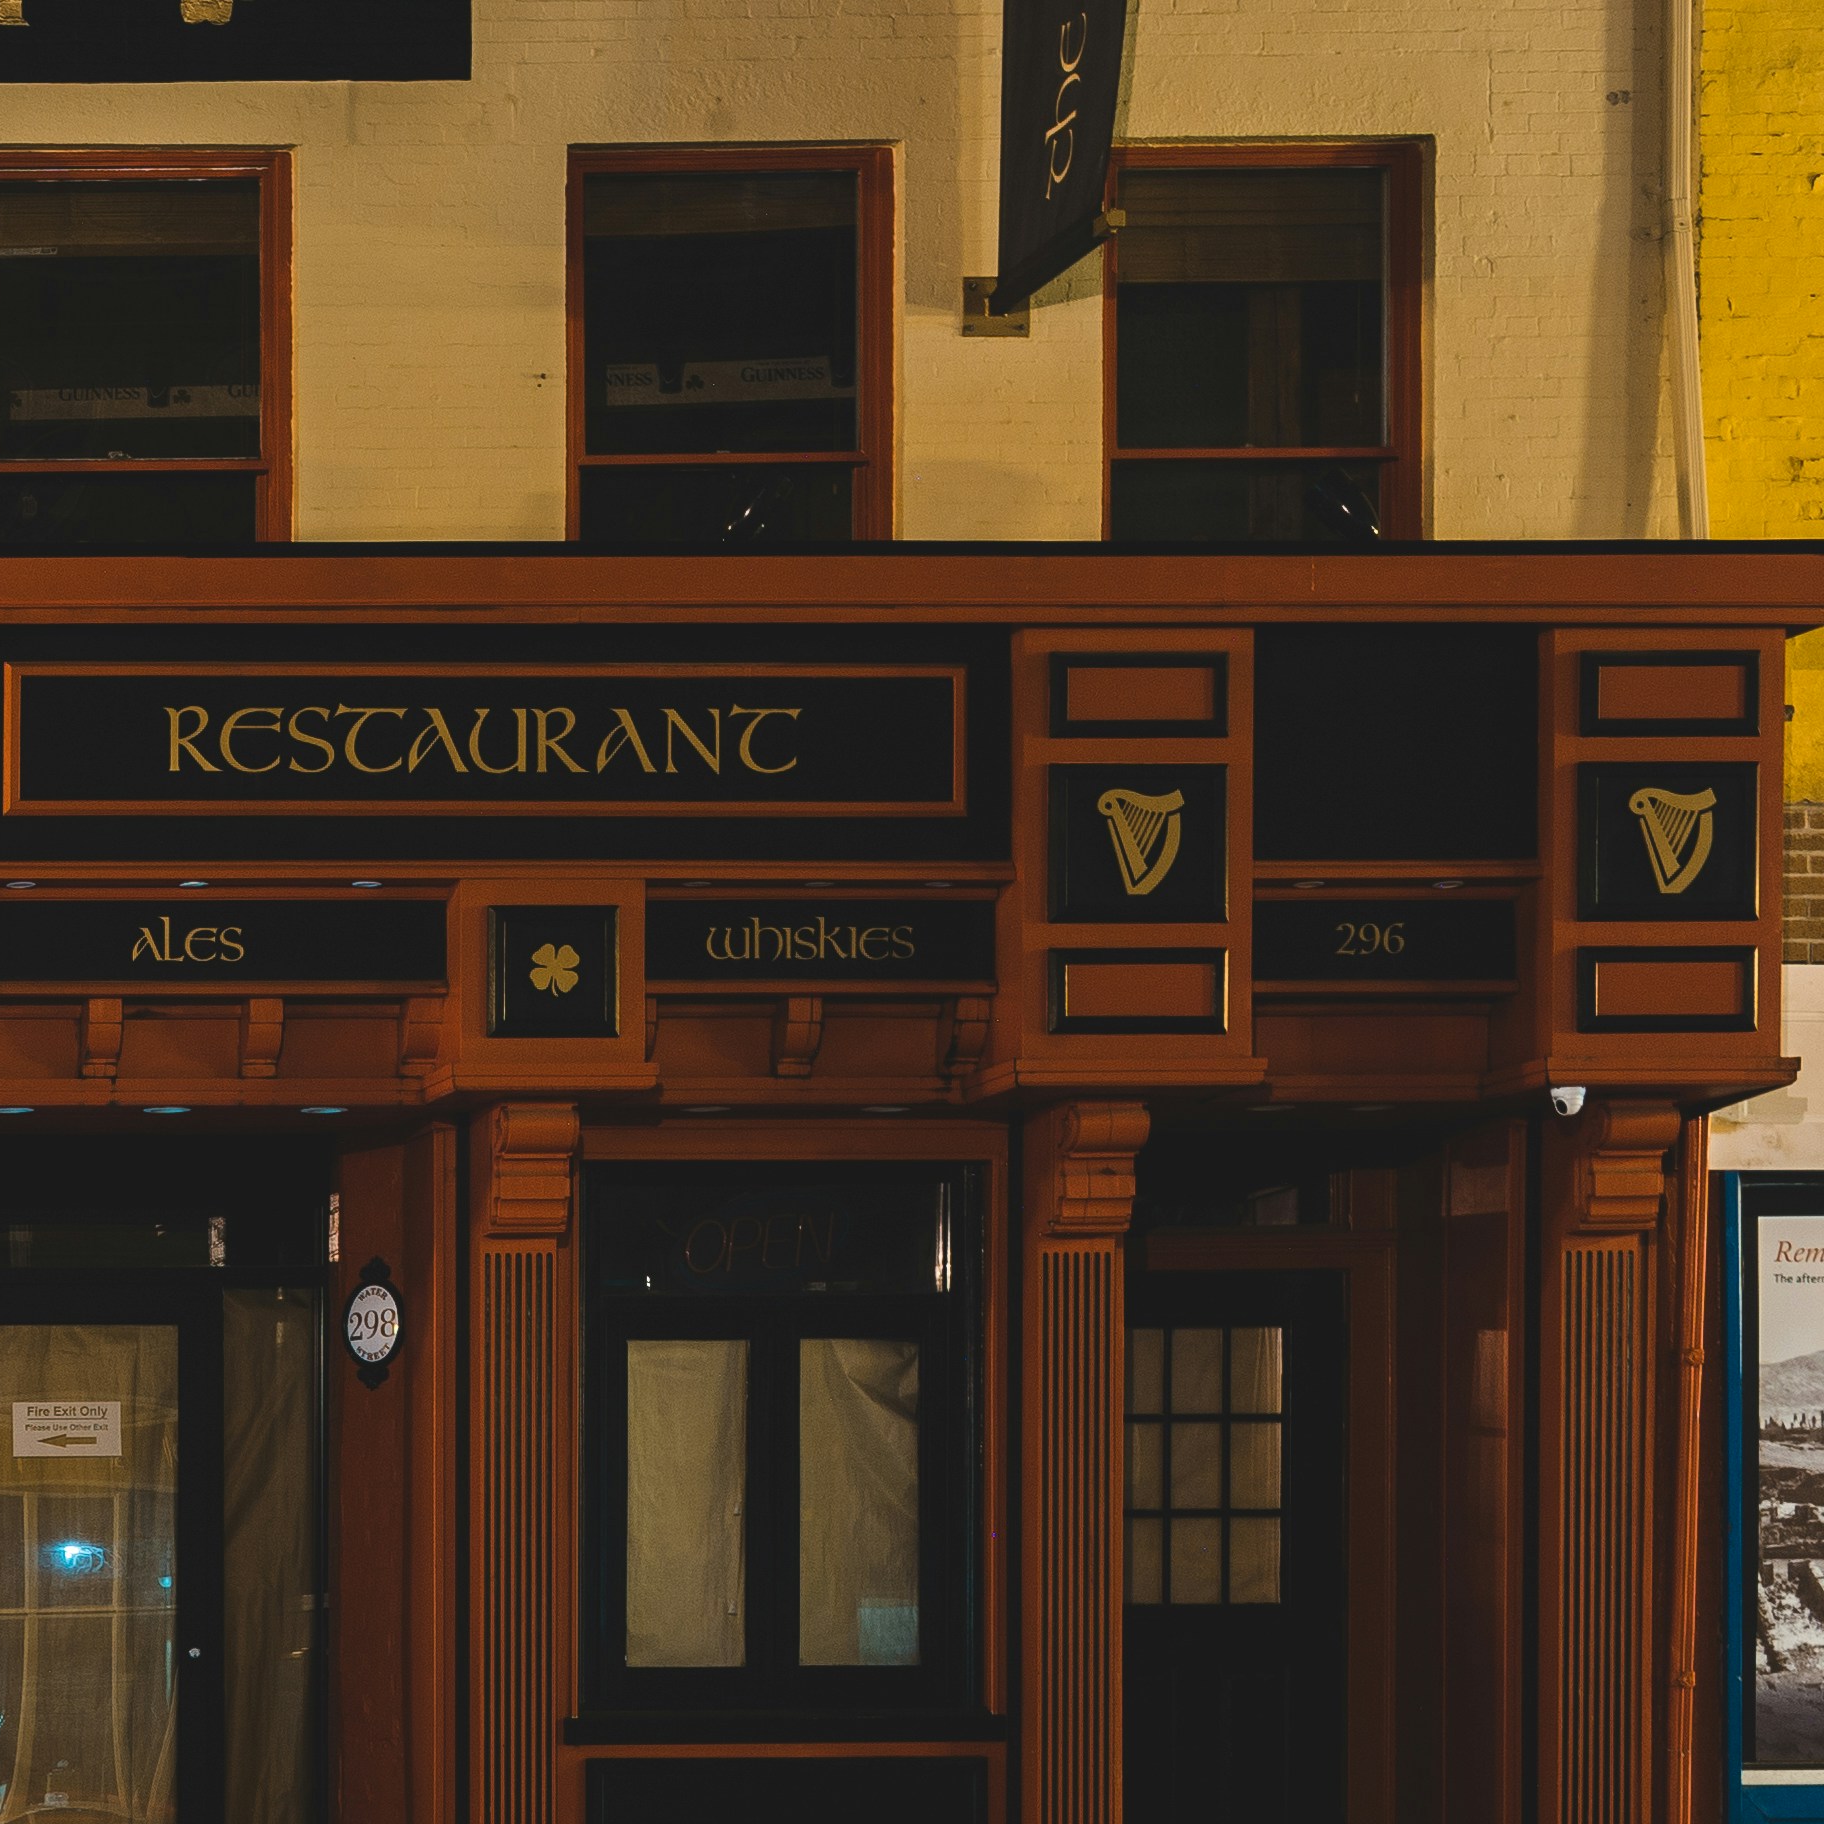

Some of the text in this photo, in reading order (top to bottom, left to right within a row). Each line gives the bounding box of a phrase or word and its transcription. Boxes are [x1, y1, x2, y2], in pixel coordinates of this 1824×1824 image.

[164, 703, 803, 775] RESTAURANT
[132, 917, 246, 963] ALES
[706, 916, 915, 961] WHISKIES
[1336, 923, 1406, 956] 296
[686, 1212, 837, 1273] OPEN
[357, 1287, 389, 1302] WATER
[1774, 1273, 1793, 1284] The
[349, 1308, 397, 1342] 298
[356, 1342, 391, 1361] STREET
[25, 1423, 109, 1432] Please Use Other Exit
[27, 1405, 108, 1419] Fire Exit Only
